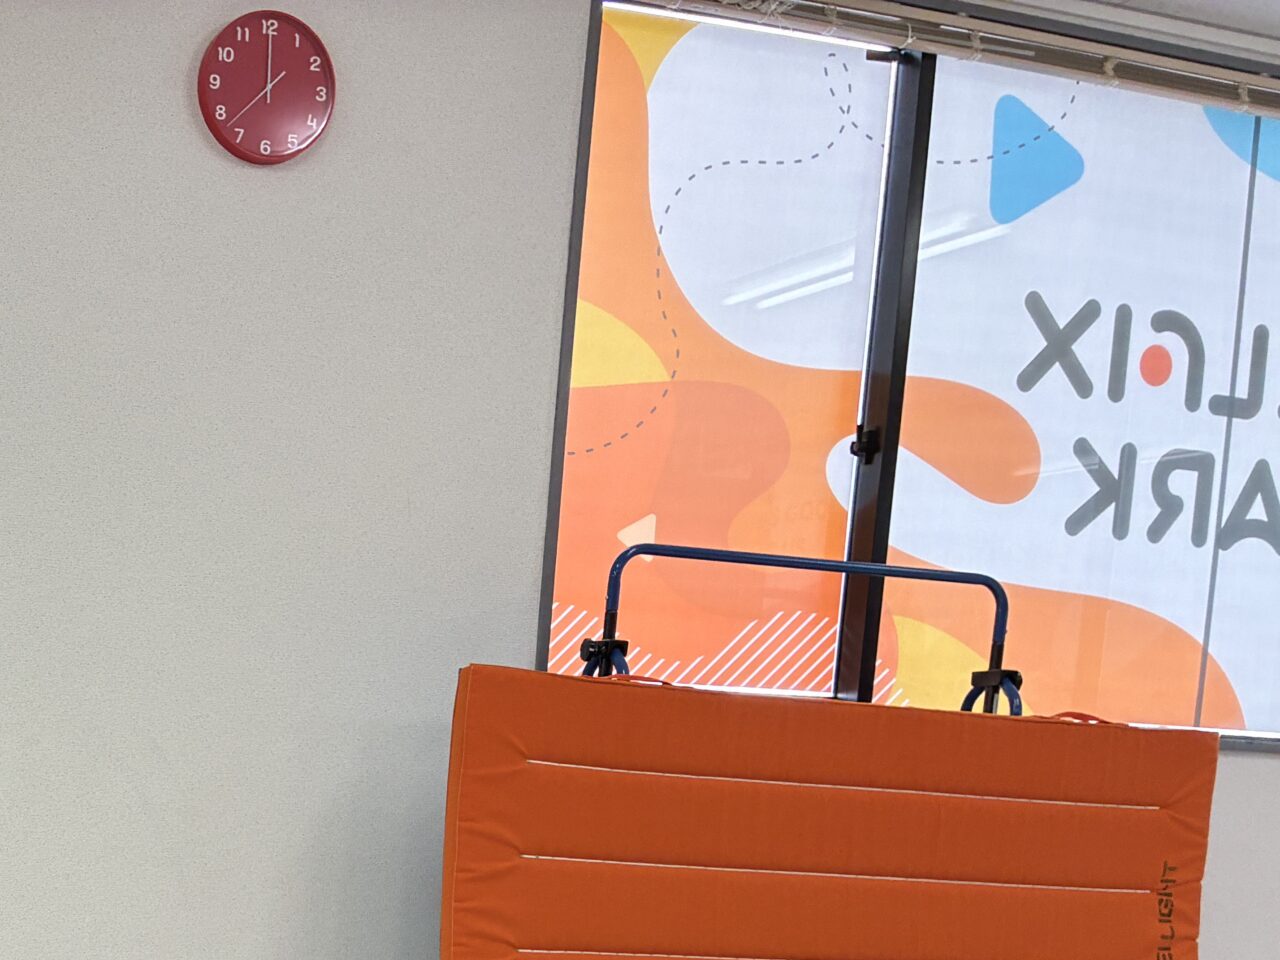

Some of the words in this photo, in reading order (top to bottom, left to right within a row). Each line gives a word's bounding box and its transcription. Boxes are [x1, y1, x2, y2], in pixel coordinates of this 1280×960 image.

[236, 26, 250, 42] 11
[262, 19, 279, 36] 12
[294, 33, 300, 48] 1
[218, 46, 235, 63] 10
[309, 56, 321, 72] 2
[209, 74, 221, 90] 9
[316, 86, 327, 102] 3
[215, 104, 227, 121] 8
[307, 113, 318, 130] 4
[234, 128, 245, 144] 7
[287, 134, 299, 150] 5
[260, 139, 272, 155] 6
